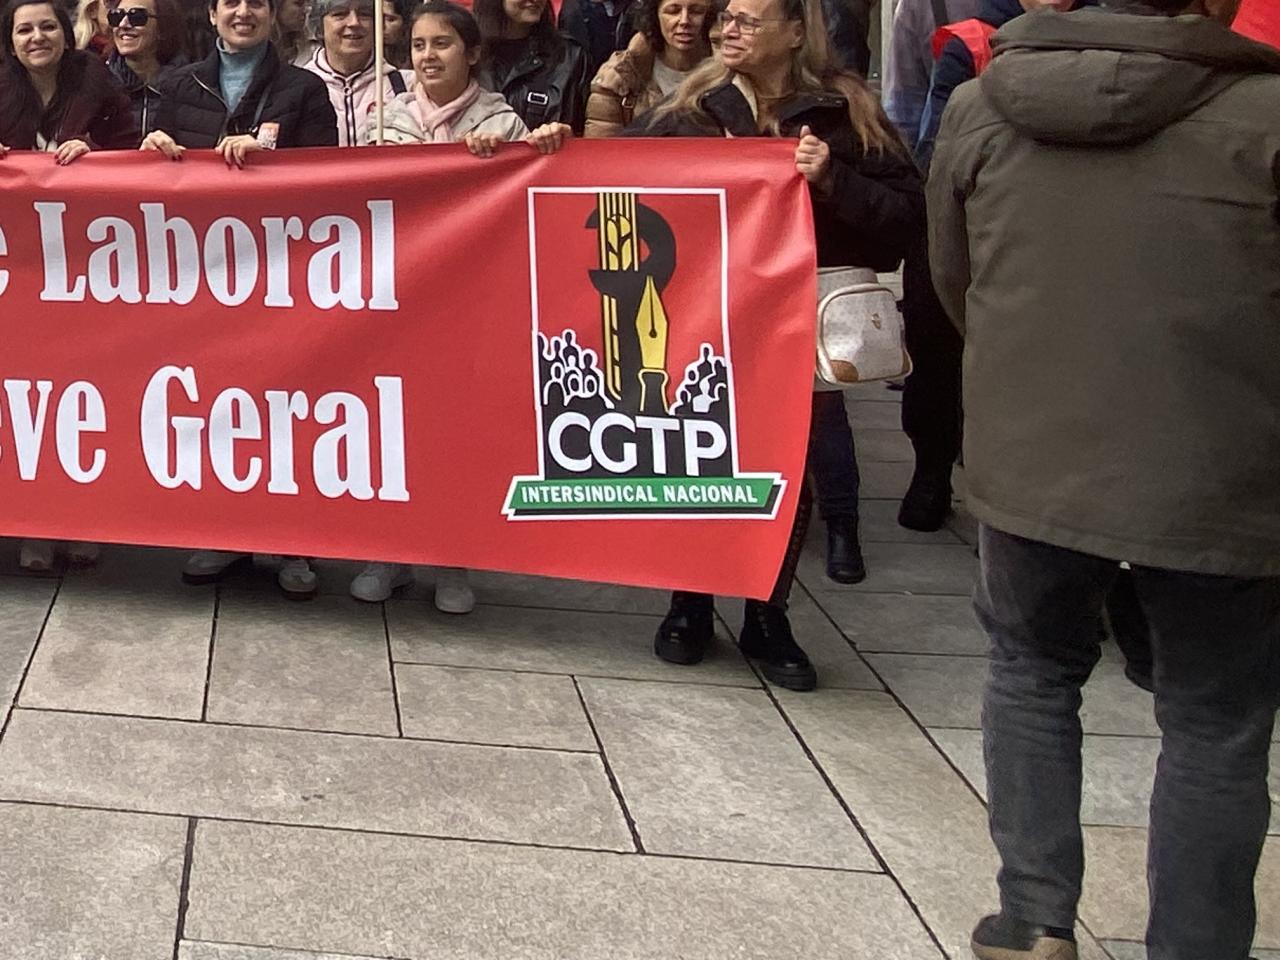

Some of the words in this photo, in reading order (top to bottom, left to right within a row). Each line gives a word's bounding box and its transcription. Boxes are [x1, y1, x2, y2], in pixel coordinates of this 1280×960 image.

[34, 200, 400, 311] Laboral
[140, 365, 410, 502] Geral
[548, 411, 728, 477] CGTP
[521, 485, 658, 503] INTERSINDICAL
[663, 485, 758, 504] NACIONAL
